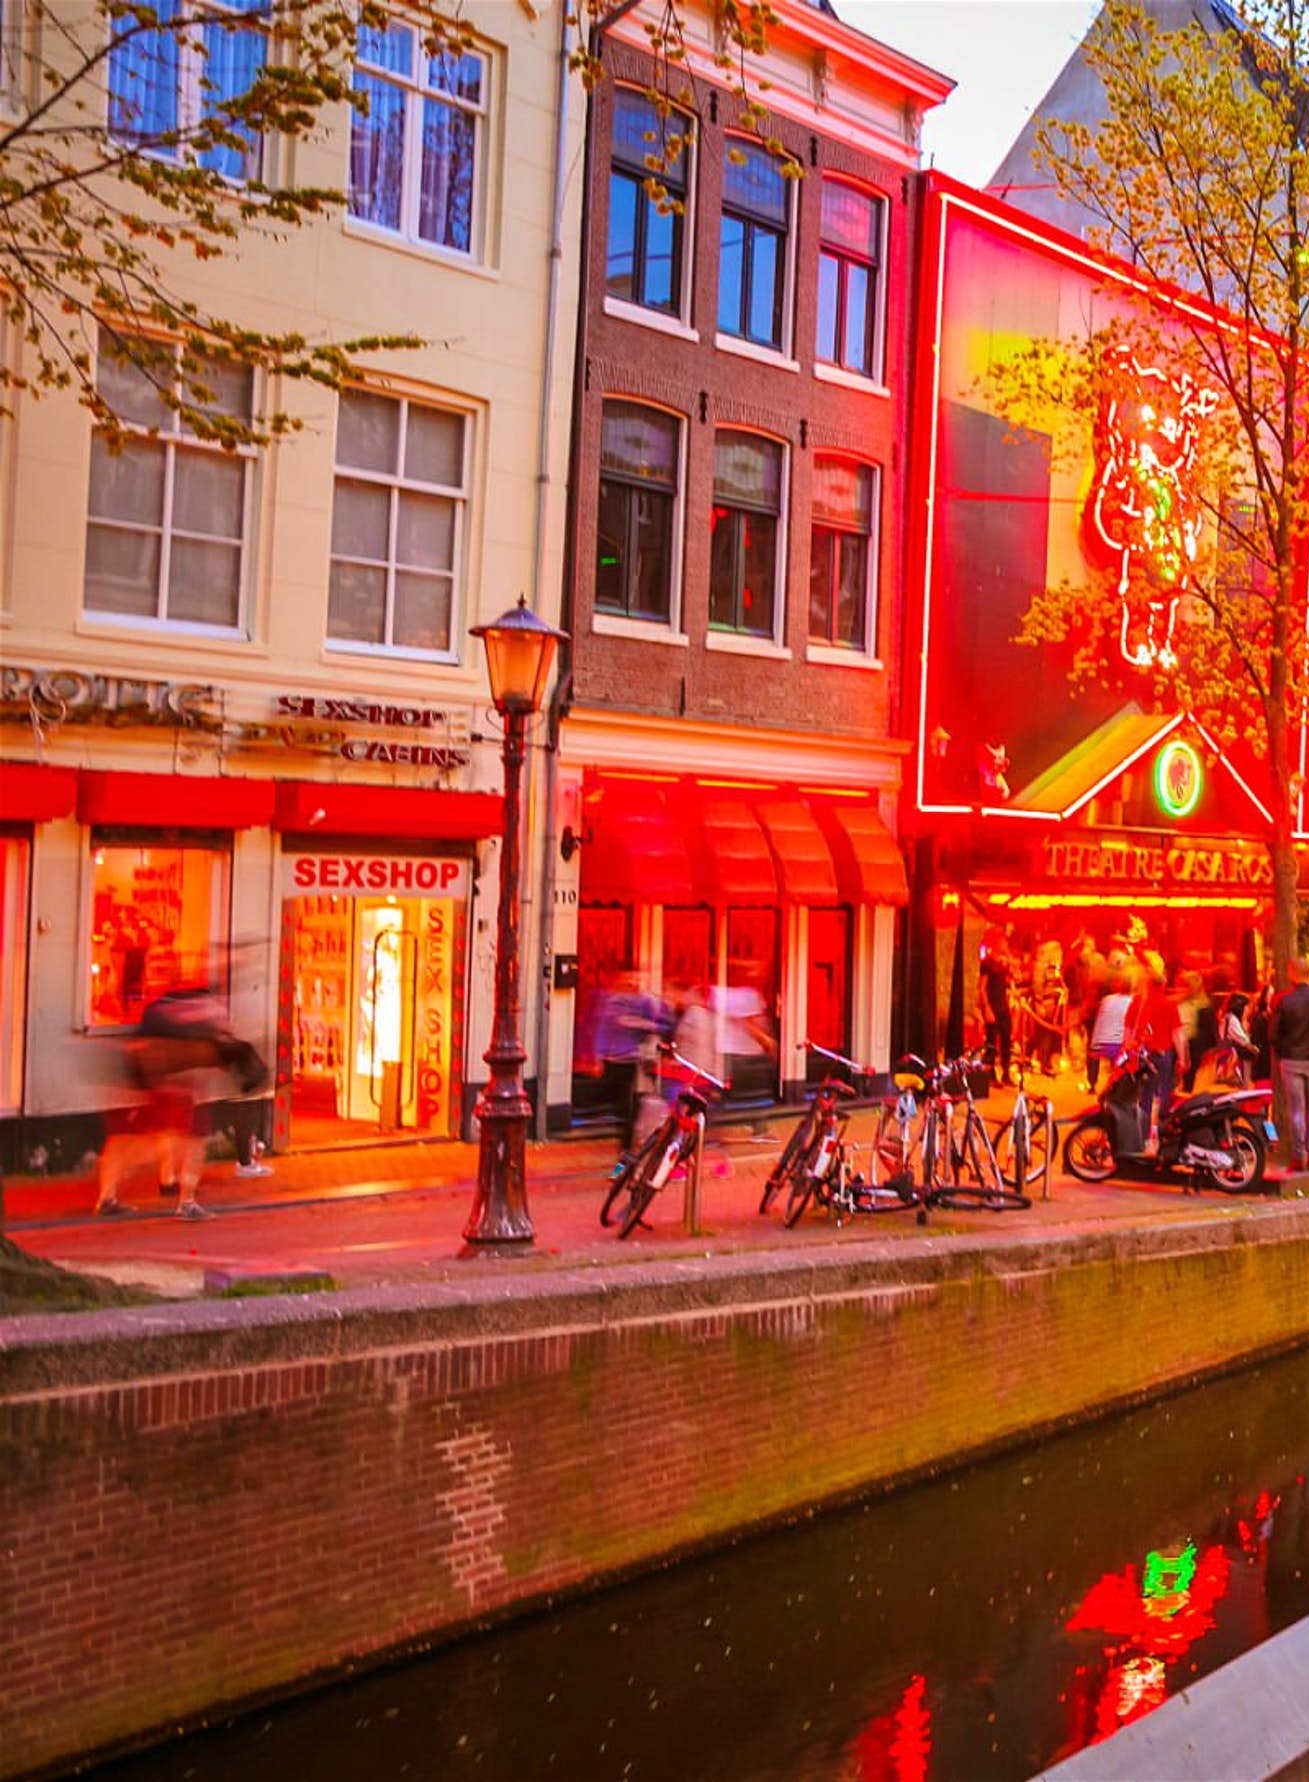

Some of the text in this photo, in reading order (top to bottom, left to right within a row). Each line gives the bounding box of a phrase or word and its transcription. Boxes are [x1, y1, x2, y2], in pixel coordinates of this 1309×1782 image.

[277, 696, 447, 728] SEXSHOP
[294, 858, 459, 889] SEXSHOP
[1046, 841, 1164, 879] THEATRE
[1166, 848, 1228, 882] CASA
[554, 890, 577, 904] 110
[424, 908, 444, 993] SEX
